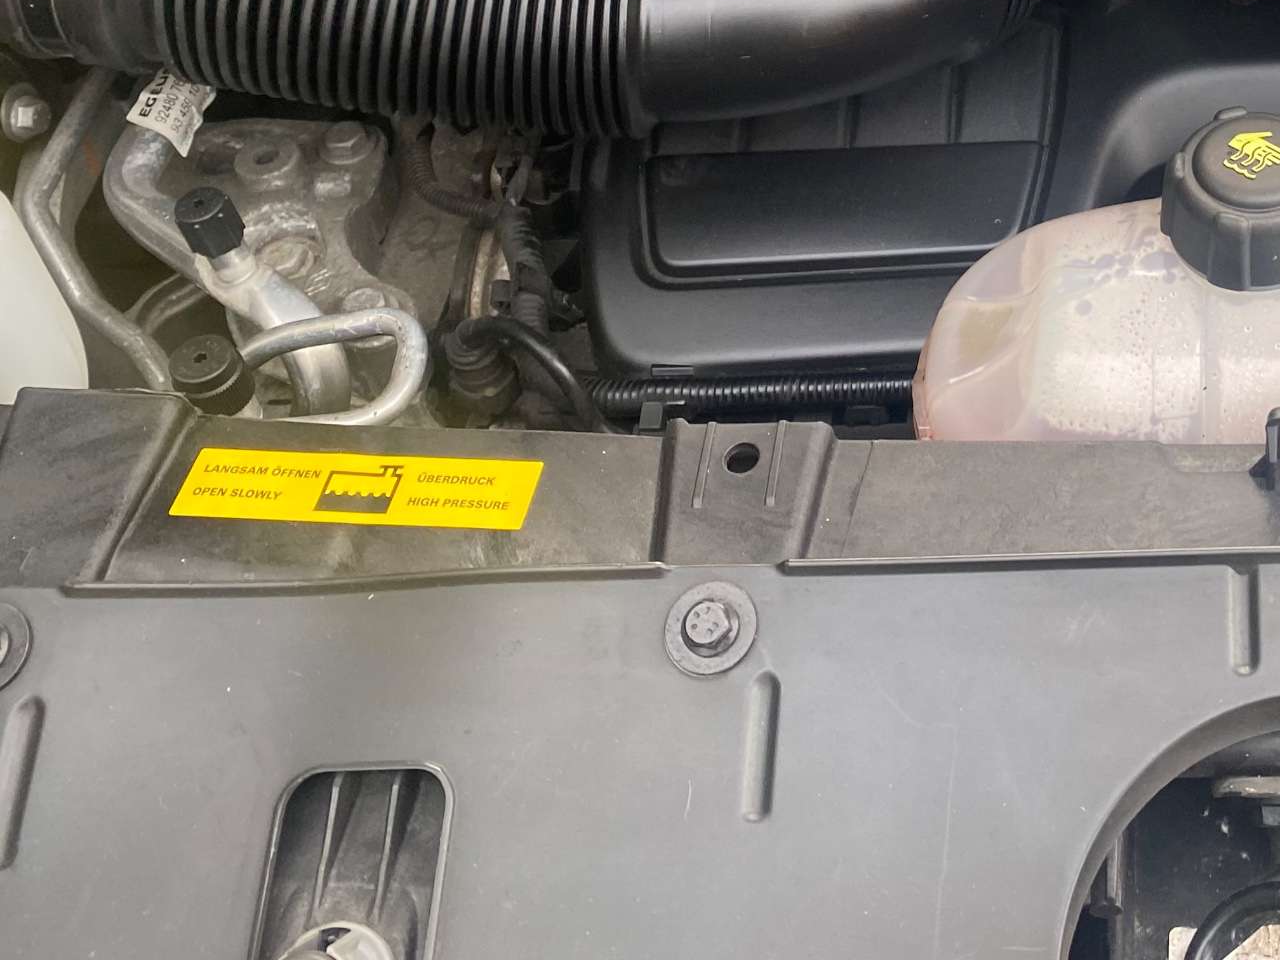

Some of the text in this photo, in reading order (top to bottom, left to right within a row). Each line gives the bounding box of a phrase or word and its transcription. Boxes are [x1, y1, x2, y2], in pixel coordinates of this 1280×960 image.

[203, 464, 322, 480] LANGSAM ÖFFNEN
[417, 472, 496, 486] ÜBERDRUCK
[192, 487, 283, 502] OPEN SLOWLY
[406, 496, 511, 511] HIGH PRESSURE
